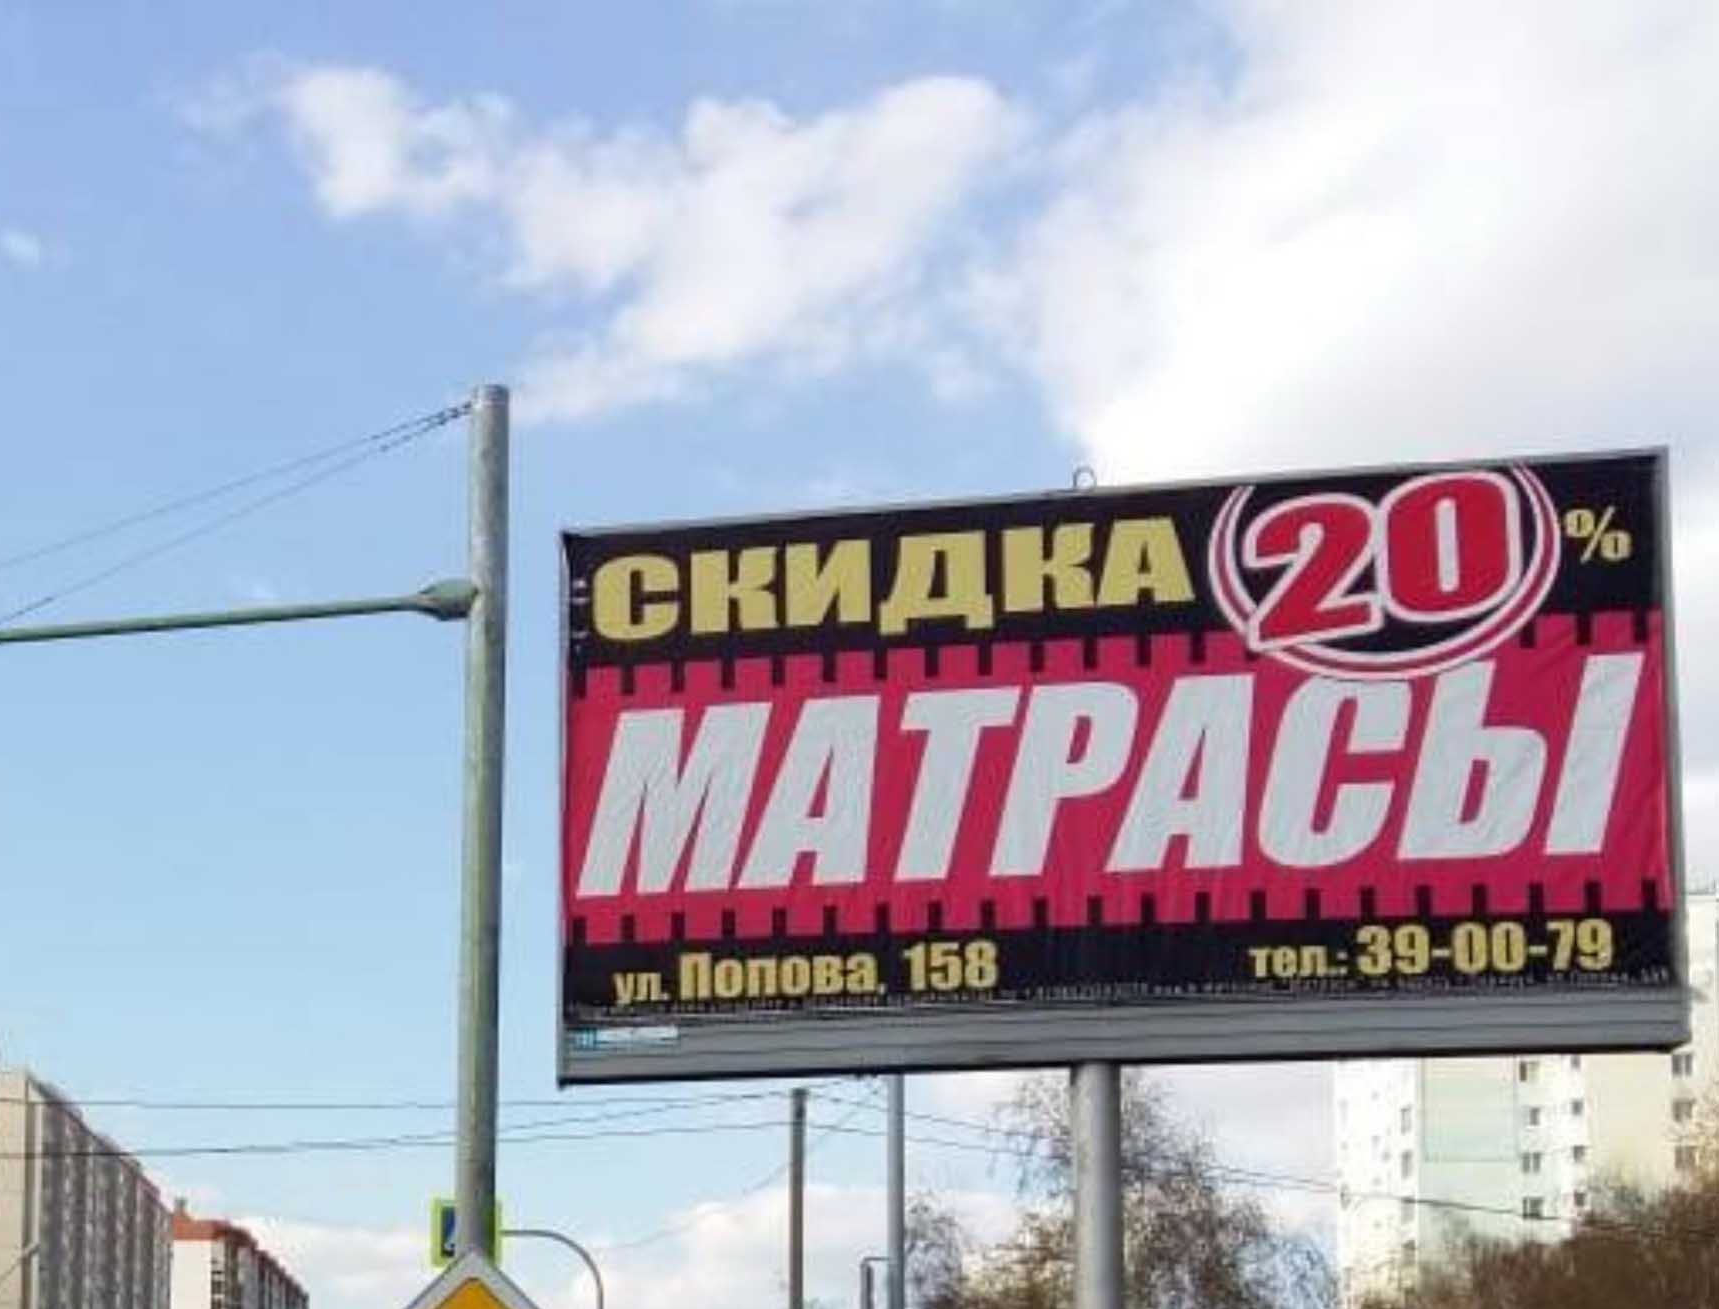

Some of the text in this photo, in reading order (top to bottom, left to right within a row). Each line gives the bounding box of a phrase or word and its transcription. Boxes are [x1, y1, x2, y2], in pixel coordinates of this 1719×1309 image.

[593, 470, 1633, 652] СКИДКА 20 %
[576, 652, 1645, 899] МАТРАСЫ
[612, 968, 671, 1006] ул.
[902, 940, 999, 991] 158
[1248, 918, 1614, 978] тел.: 39-00-79
